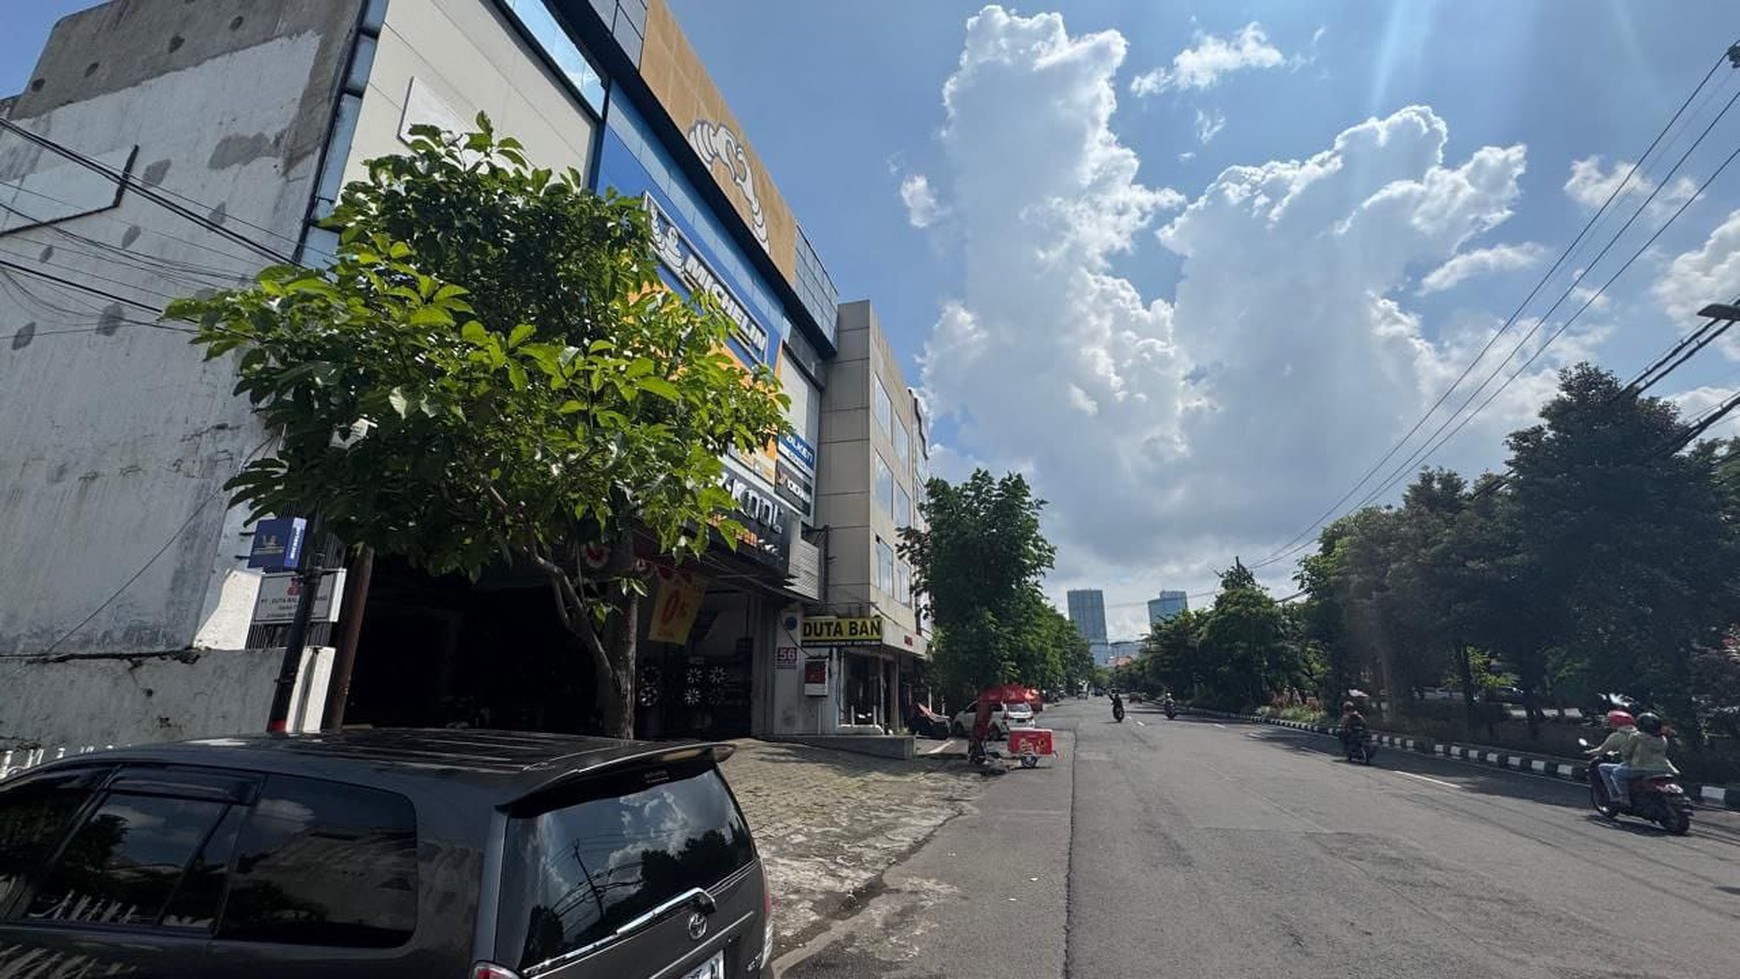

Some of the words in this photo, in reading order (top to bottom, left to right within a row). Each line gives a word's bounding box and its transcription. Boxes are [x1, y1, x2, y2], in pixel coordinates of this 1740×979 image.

[684, 254, 767, 353] MICHELIN
[803, 621, 845, 637] DUTA
[848, 620, 881, 636] BAN
[779, 649, 795, 660] 56
